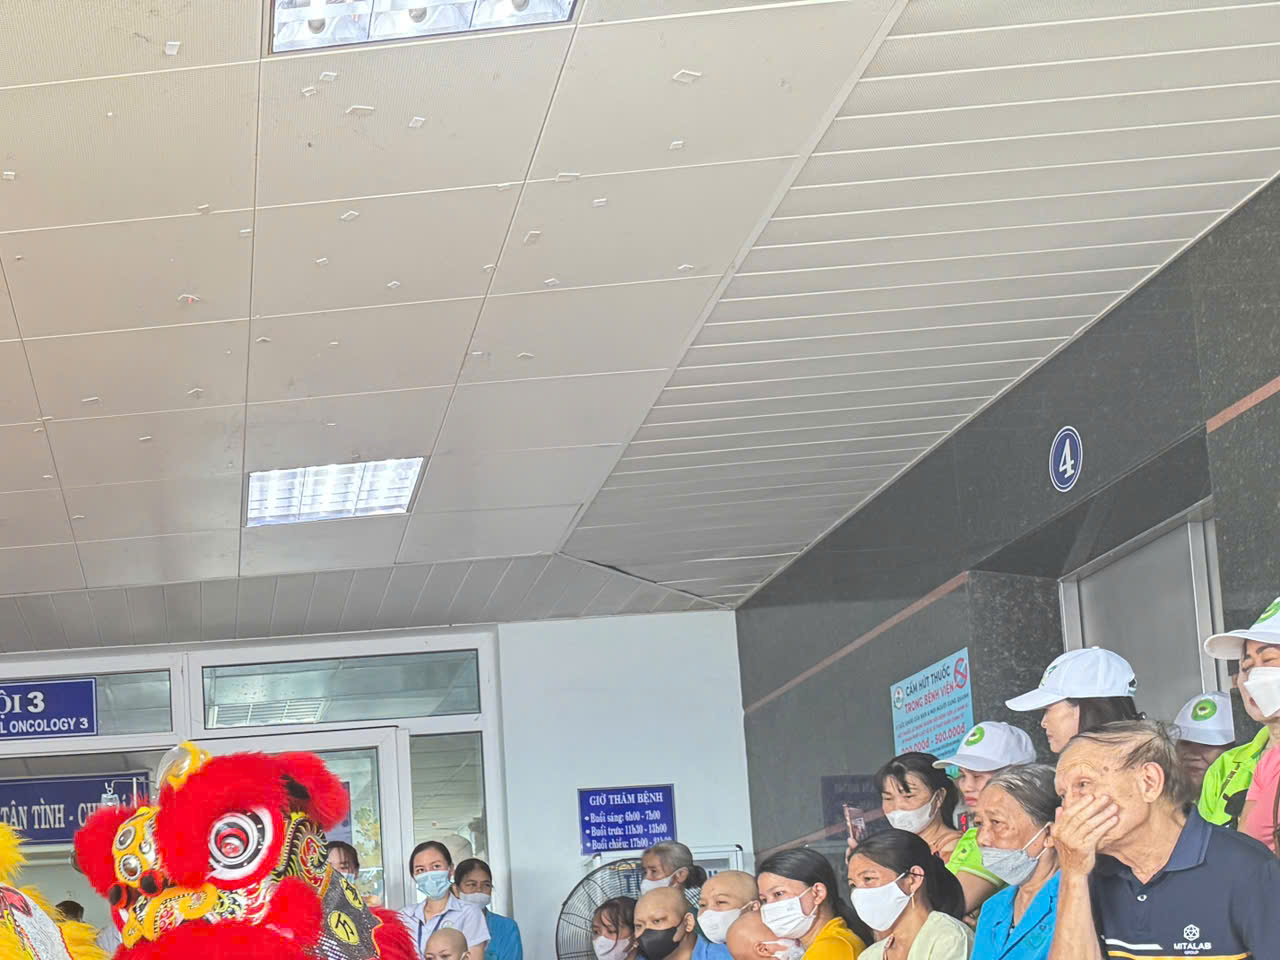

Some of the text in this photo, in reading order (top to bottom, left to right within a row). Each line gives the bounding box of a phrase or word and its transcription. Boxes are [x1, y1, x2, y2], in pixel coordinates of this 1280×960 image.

[1059, 438, 1074, 478] 4
[919, 675, 930, 690] HÚT
[931, 664, 951, 683] THUỐC
[27, 691, 45, 713] 3
[9, 717, 76, 734] ONCOLOGY
[80, 718, 89, 729] 3
[589, 791, 663, 806] GIỜ THĂM BỆNH
[31, 797, 66, 829] TÌNH
[1173, 942, 1212, 950] MITALAB
